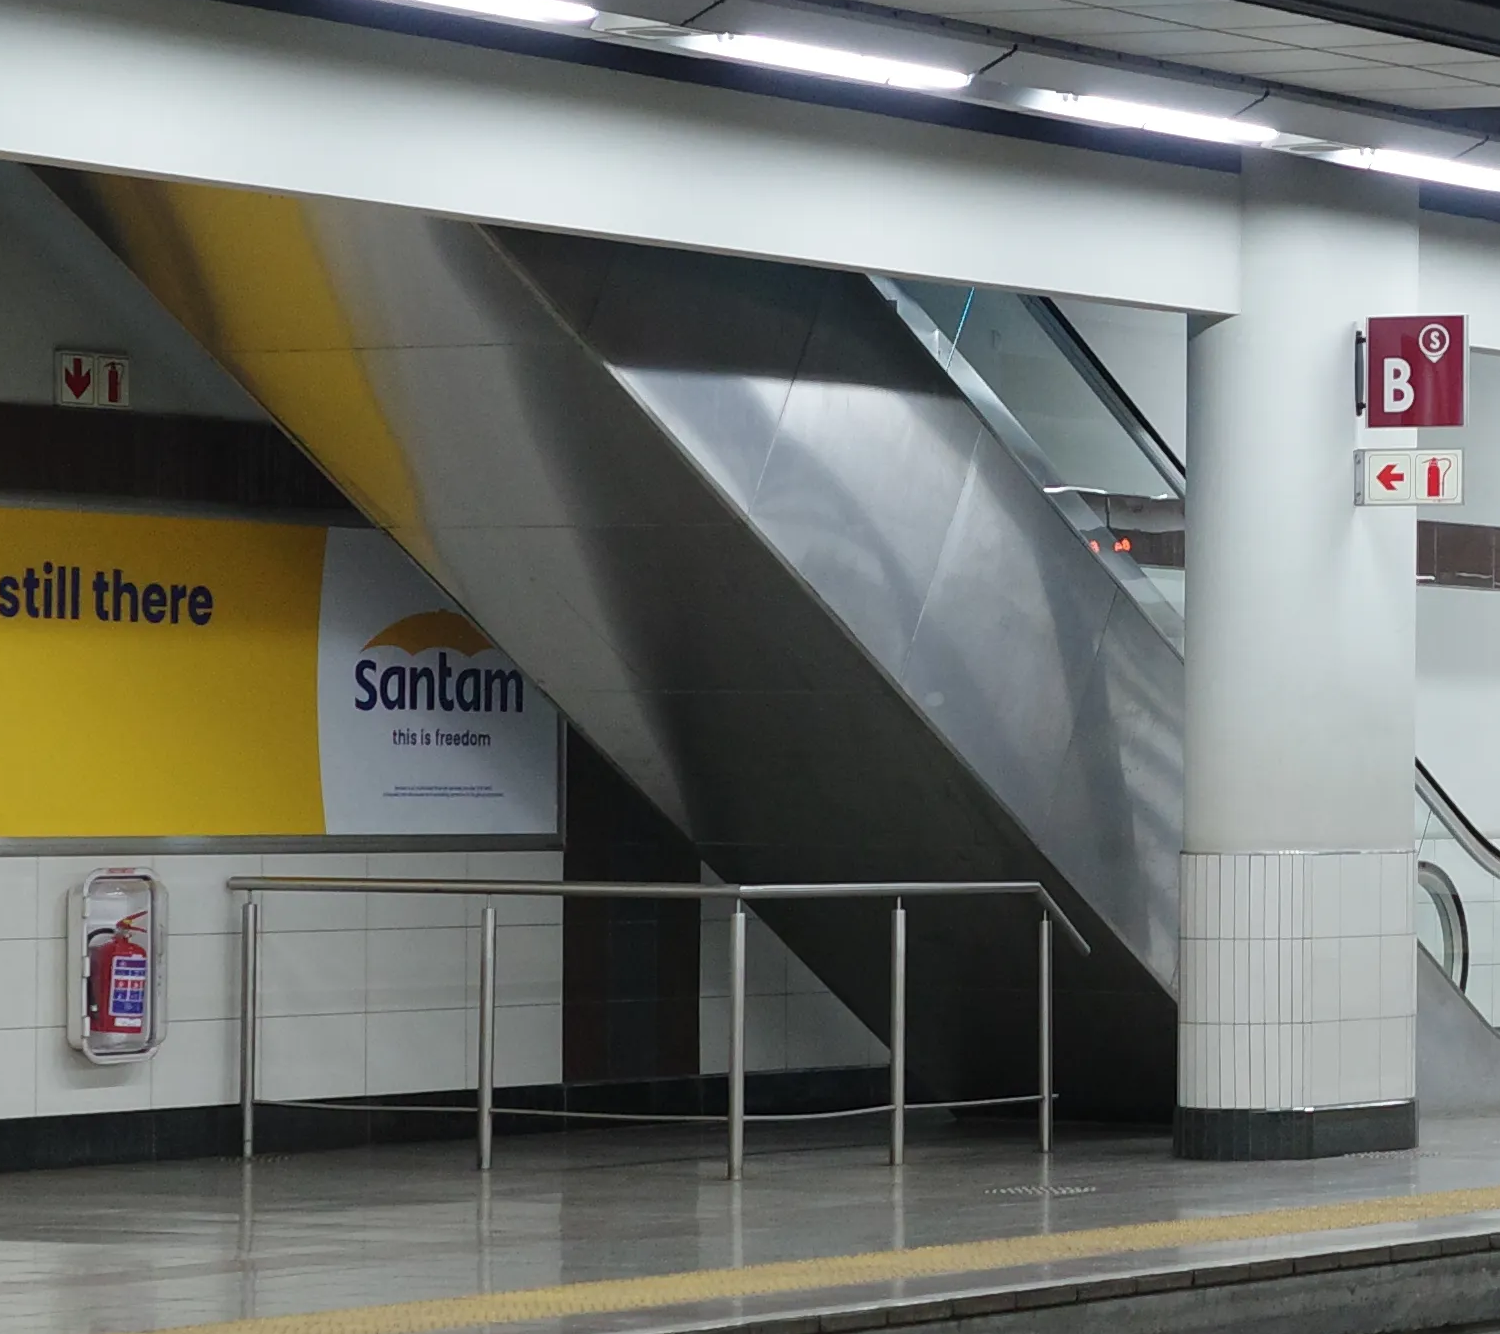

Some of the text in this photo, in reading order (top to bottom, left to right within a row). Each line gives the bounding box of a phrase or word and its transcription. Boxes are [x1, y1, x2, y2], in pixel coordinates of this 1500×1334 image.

[1383, 357, 1415, 413] B
[92, 568, 213, 625] there
[354, 651, 524, 713] Santam
[392, 728, 491, 748] this is freedom
